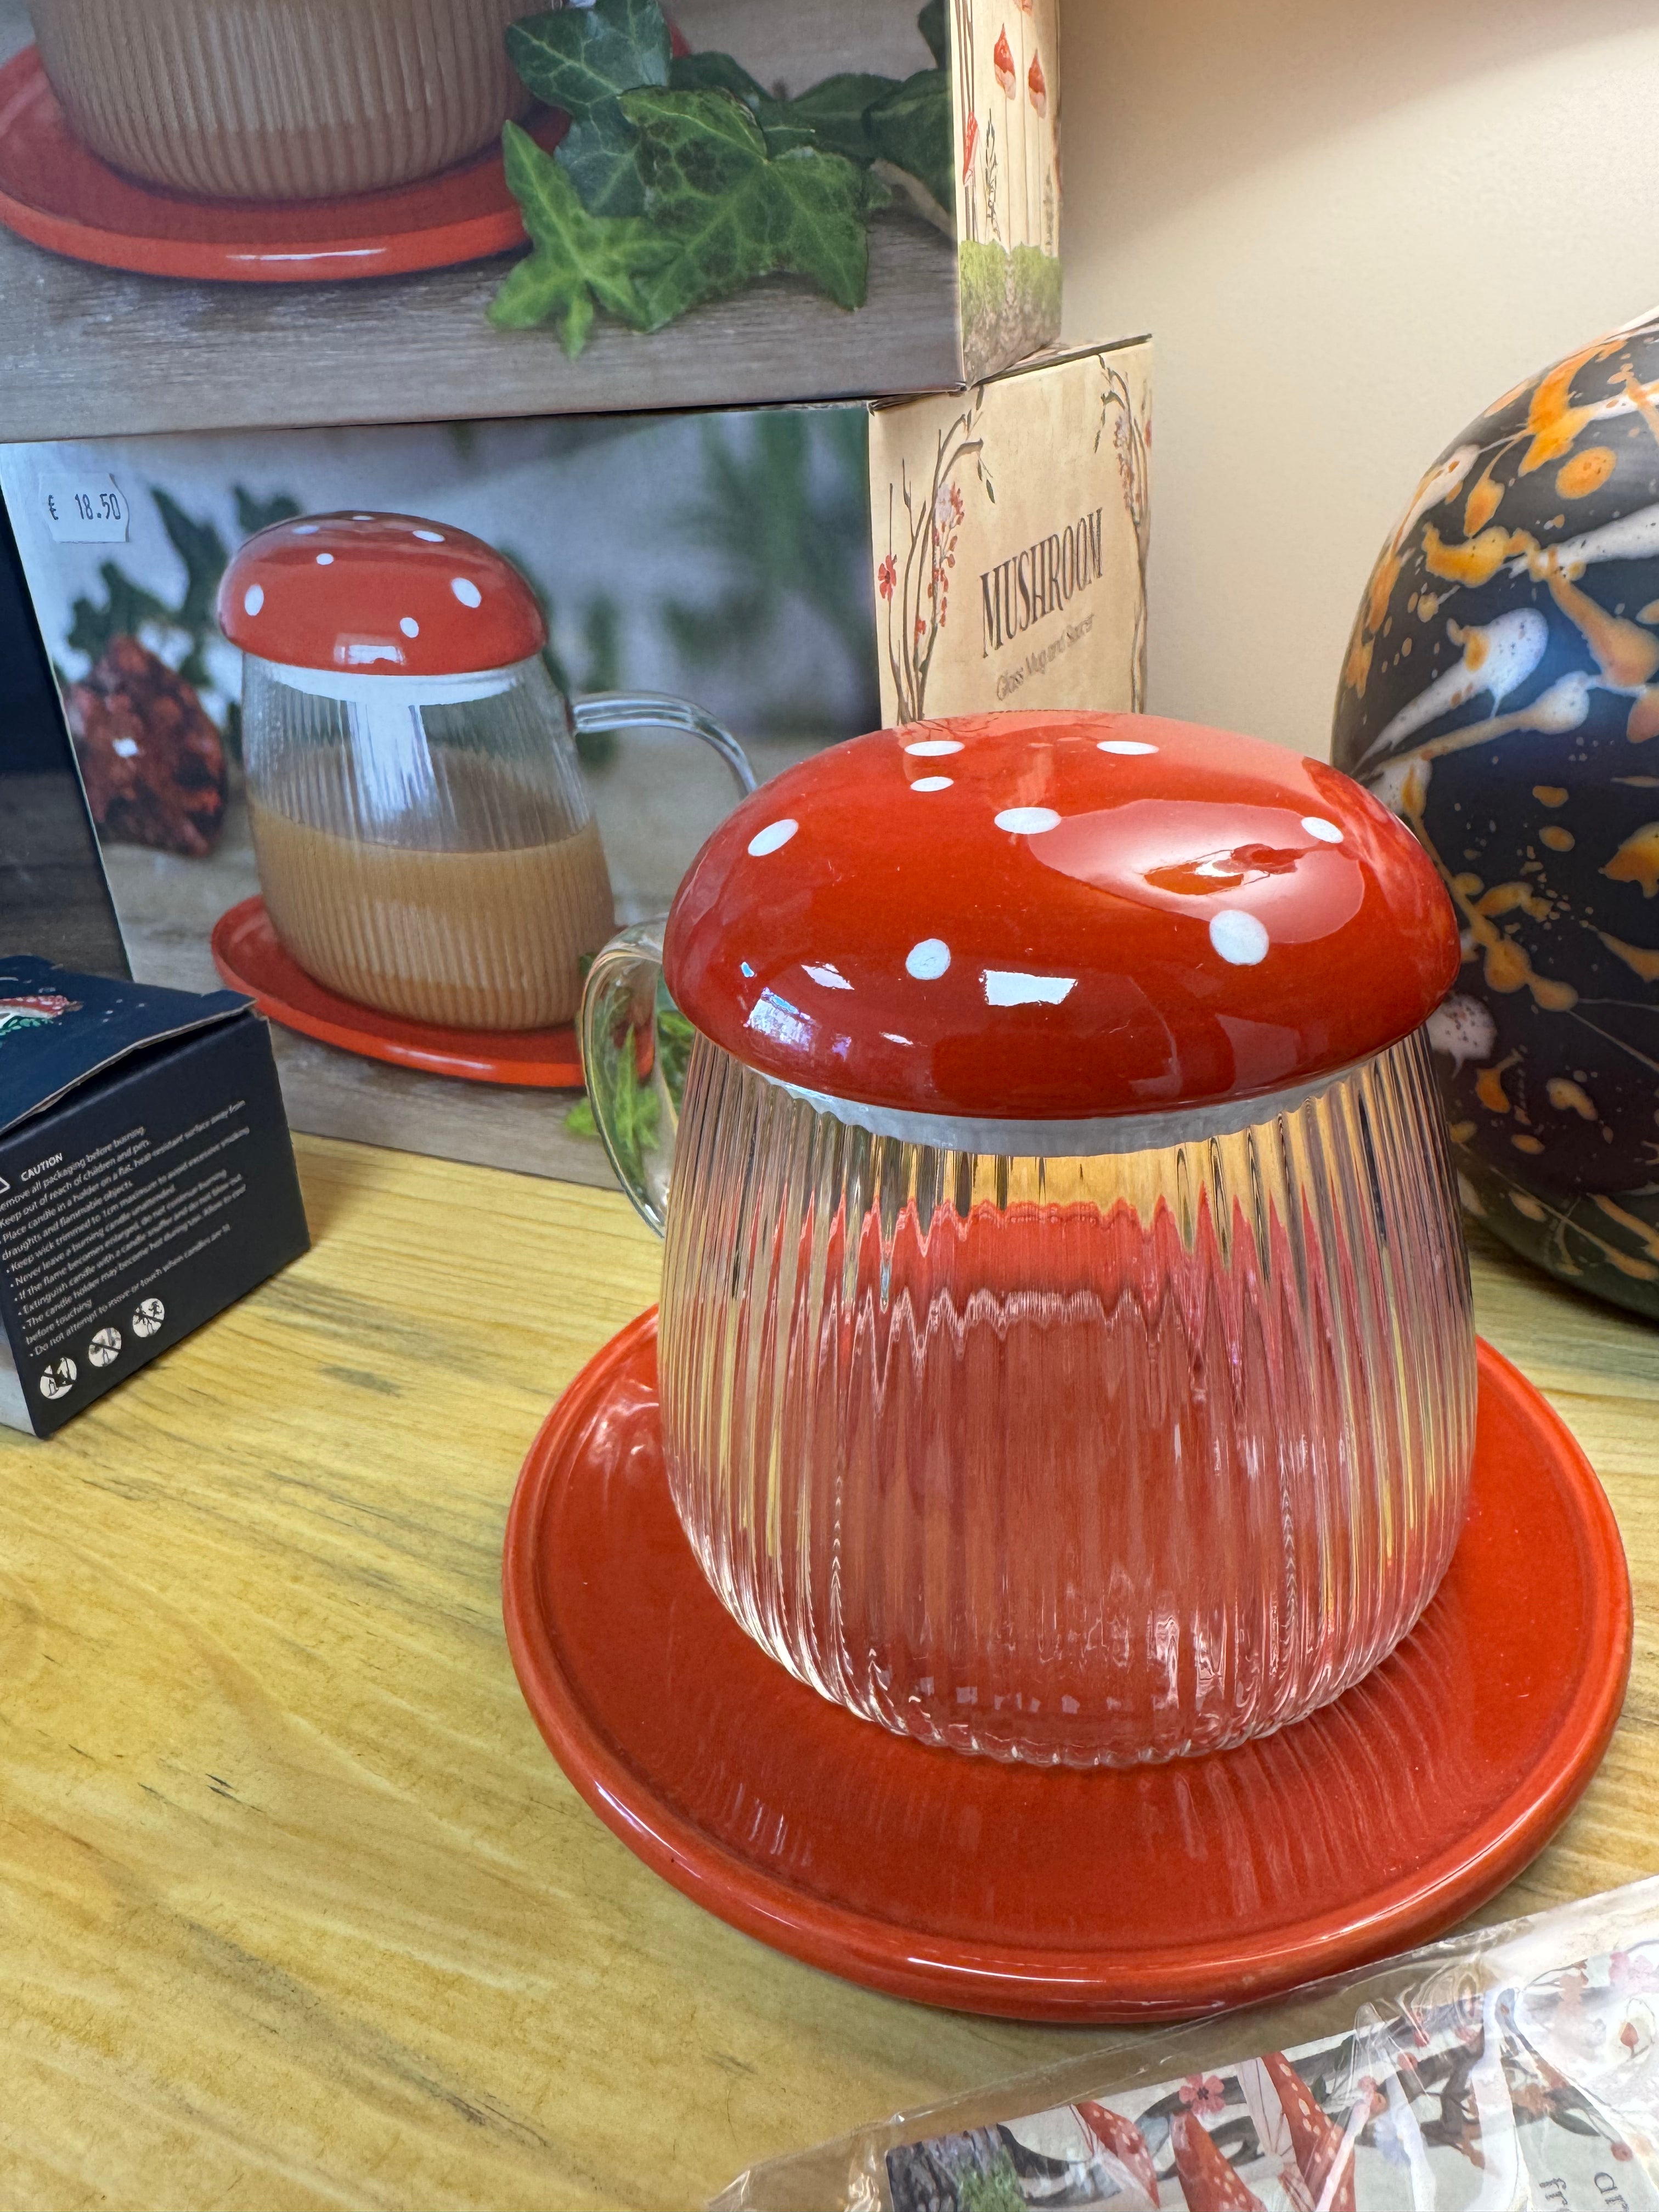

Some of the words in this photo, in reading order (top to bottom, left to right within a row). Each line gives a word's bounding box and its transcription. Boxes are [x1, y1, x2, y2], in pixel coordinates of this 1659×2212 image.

[48, 494, 59, 520] €
[75, 493, 121, 520] 18.50
[979, 506, 1103, 658] MUSHROOM
[0, 1189, 30, 1212] emove
[32, 1180, 42, 1194] all
[42, 1158, 86, 1189] packaging
[21, 1153, 63, 1181] CAUTION
[0, 1211, 22, 1228] Keep
[22, 1201, 38, 1215] out
[39, 1193, 48, 1206] of
[49, 1182, 72, 1200] reach
[74, 1173, 82, 1186] of
[116, 1146, 132, 1163] and
[2, 1226, 26, 1243] Place
[28, 1208, 56, 1229] candle
[57, 1203, 66, 1212] in
[67, 1199, 72, 1207] a
[2, 1234, 42, 1261] draughts
[42, 1221, 60, 1237] and
[10, 1254, 35, 1272] Keep
[15, 1266, 41, 1286] Never
[42, 1252, 65, 1270] leave
[19, 1289, 26, 1300] If
[26, 1283, 42, 1295] the
[22, 1283, 68, 1314] Extinguish
[69, 1266, 95, 1286] candle
[26, 1314, 44, 1327] The
[45, 1296, 72, 1317] candle
[25, 1323, 55, 1345] before
[35, 1343, 49, 1355] Do
[49, 1332, 65, 1346] not
[66, 1310, 98, 1336] attempt
